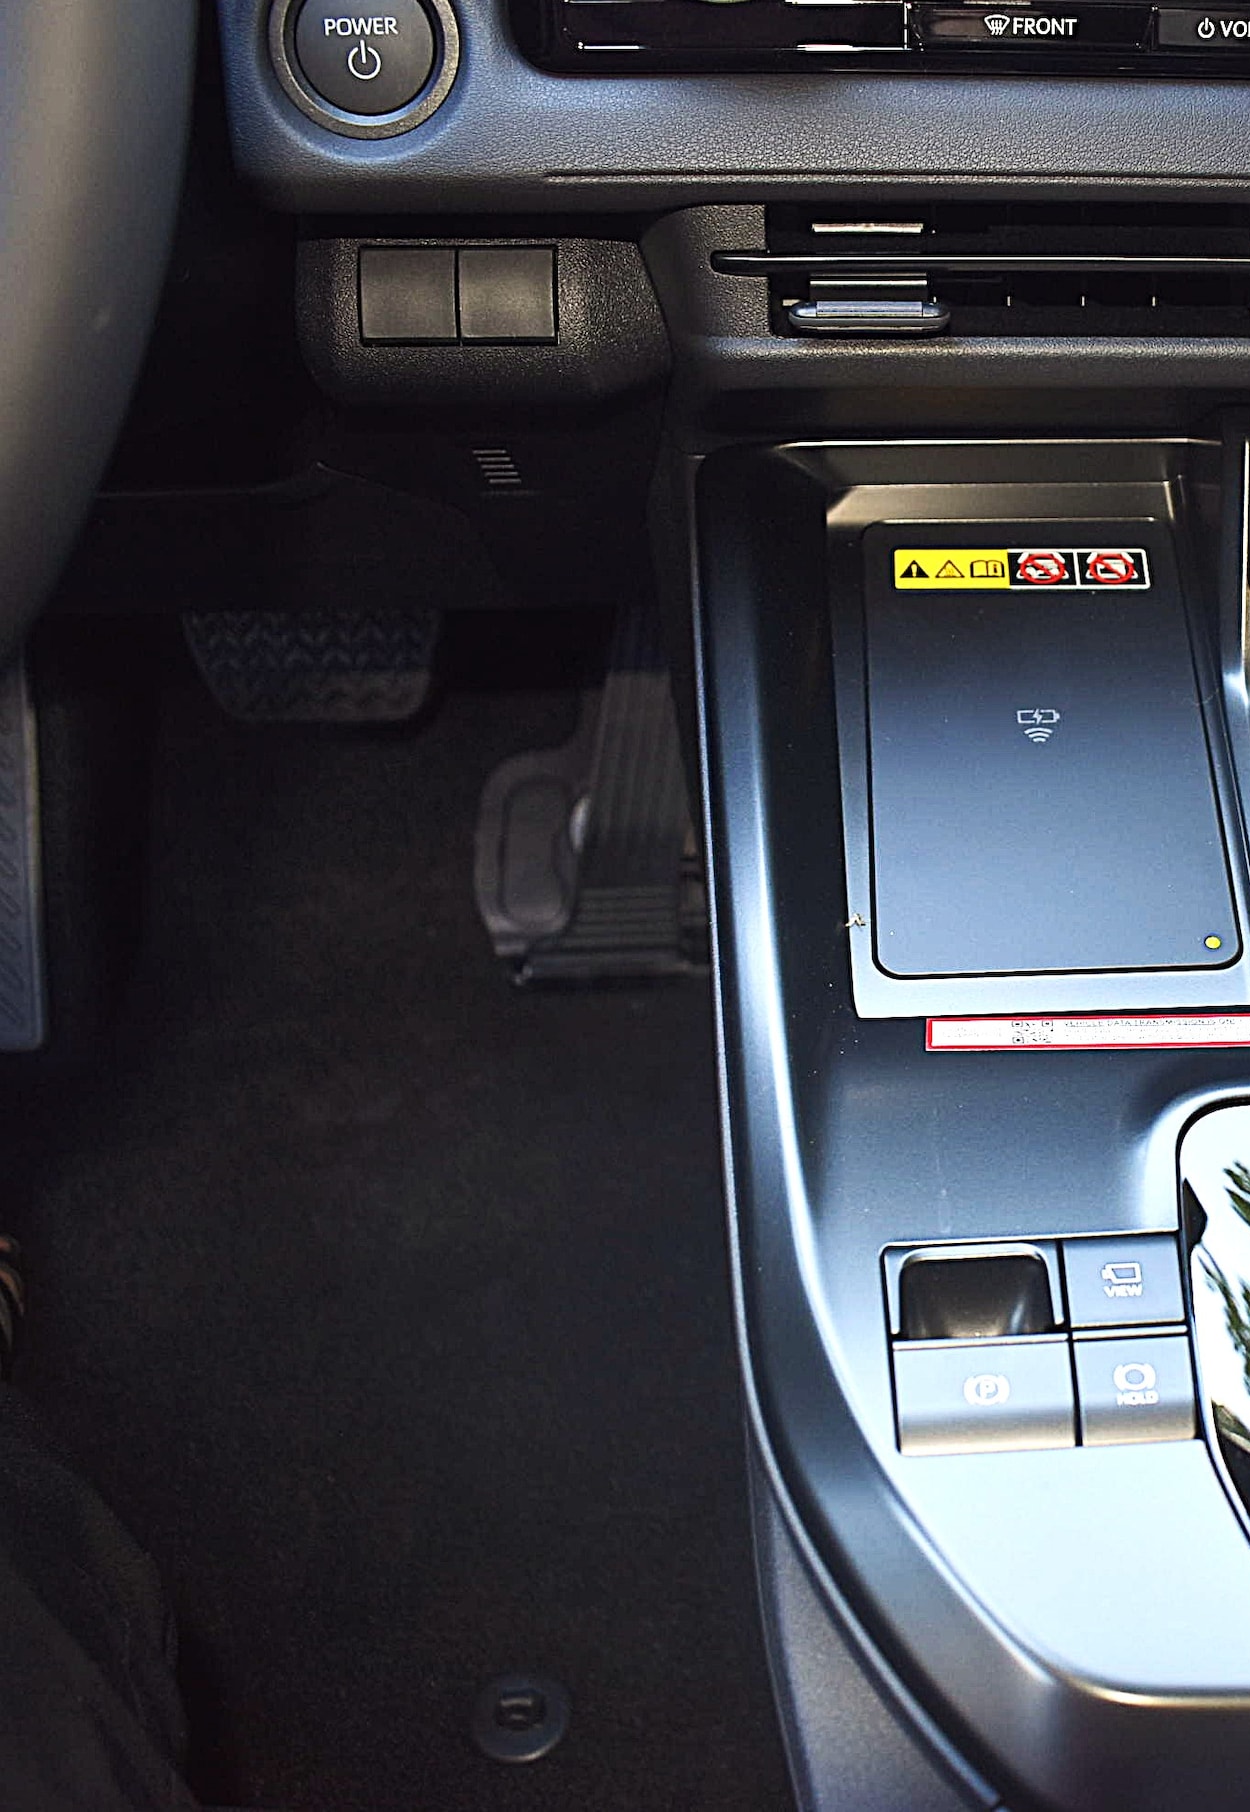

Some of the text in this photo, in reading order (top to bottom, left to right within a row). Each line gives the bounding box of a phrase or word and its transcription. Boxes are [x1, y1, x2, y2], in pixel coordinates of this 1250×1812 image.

[323, 16, 399, 37] POWER
[1012, 17, 1078, 36] FRONT
[1103, 1284, 1144, 1298] VIEW
[1116, 1390, 1160, 1407] HOLD
